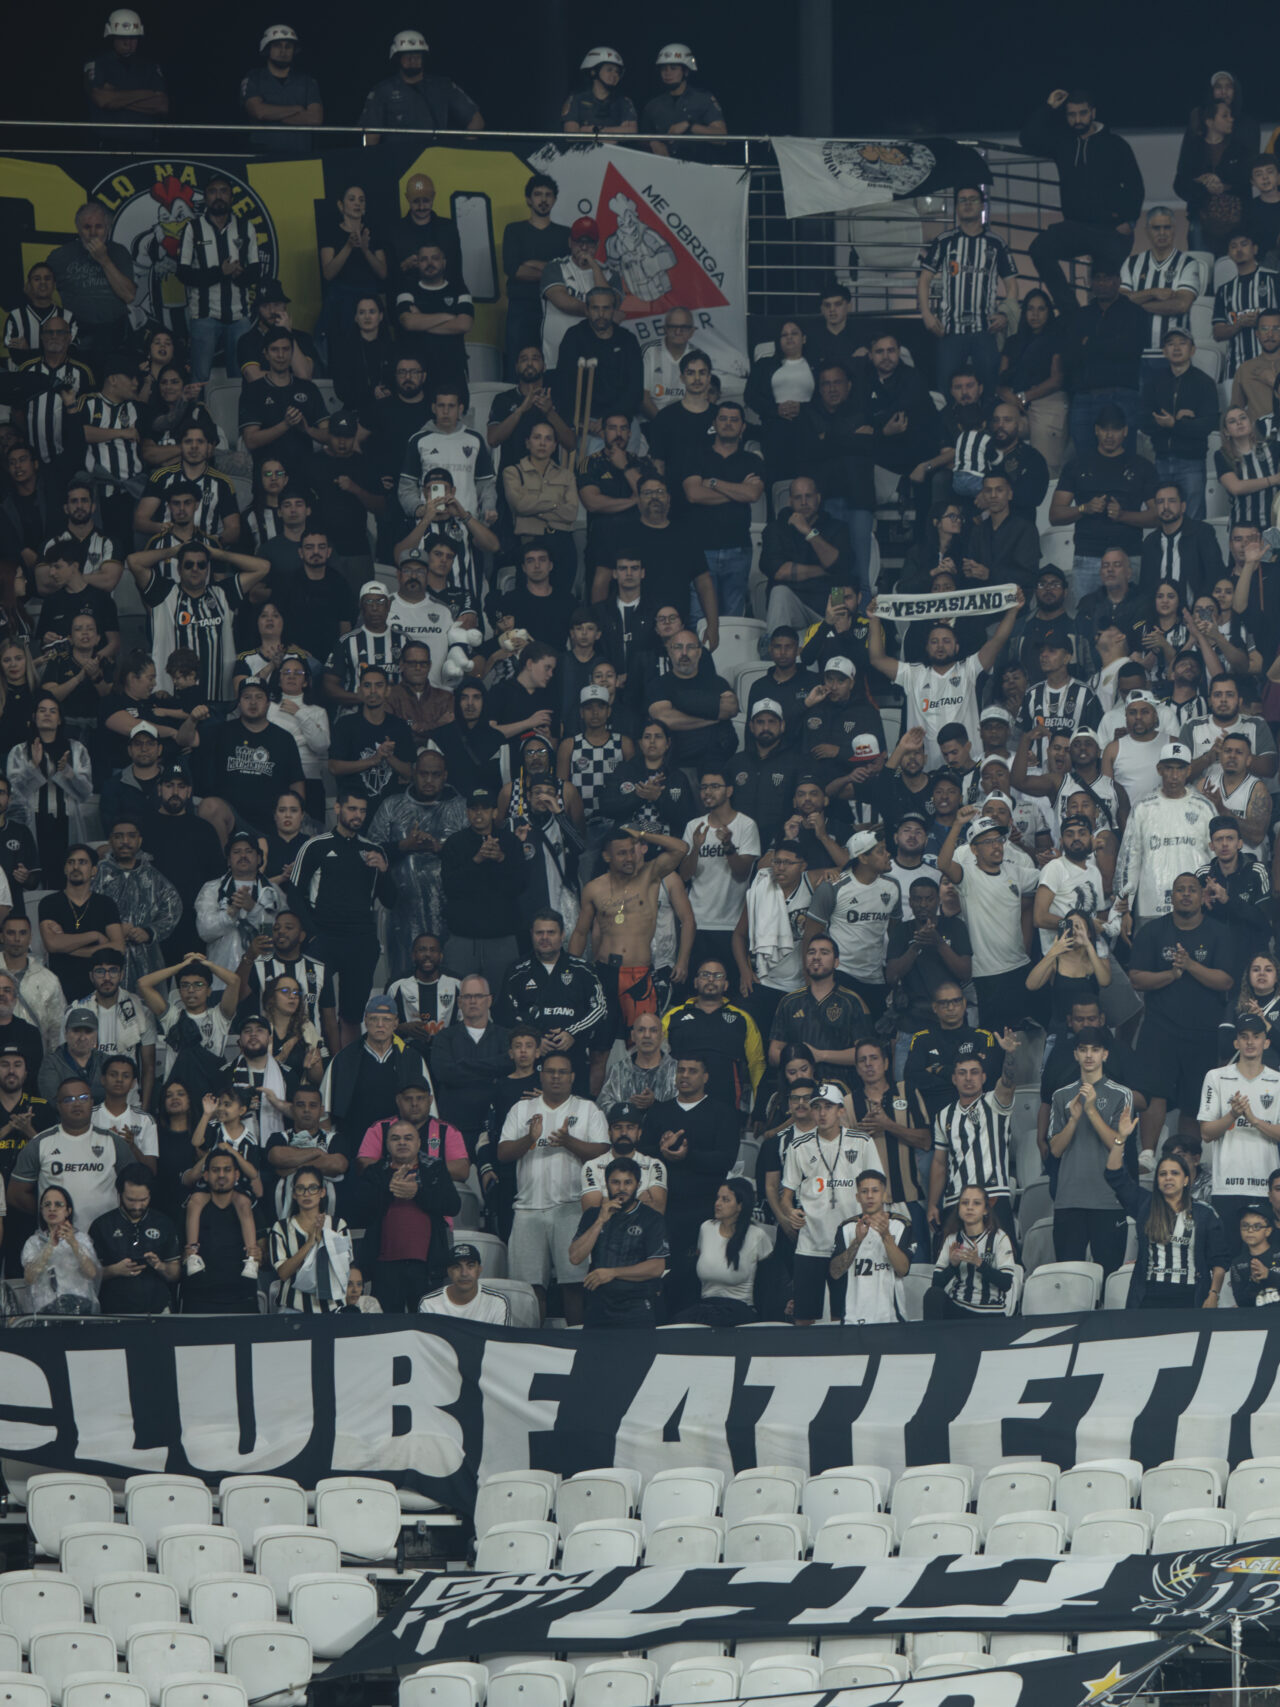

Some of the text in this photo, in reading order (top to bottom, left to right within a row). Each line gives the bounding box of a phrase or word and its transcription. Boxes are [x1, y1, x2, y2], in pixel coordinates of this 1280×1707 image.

[155, 163, 198, 186] NA
[577, 198, 593, 215] O
[641, 184, 727, 289] ME OBRIGA
[635, 312, 715, 341] BER
[891, 592, 1004, 617] VESPASIANO
[404, 625, 442, 634] BETANO
[930, 696, 963, 709] BETANO
[1044, 717, 1075, 728] BETANO
[1163, 836, 1197, 846] BETANO
[860, 912, 889, 921] BETAN
[64, 1162, 104, 1172] BETANO
[1226, 1177, 1245, 1186] AUTO
[854, 1259, 873, 1277] H2
